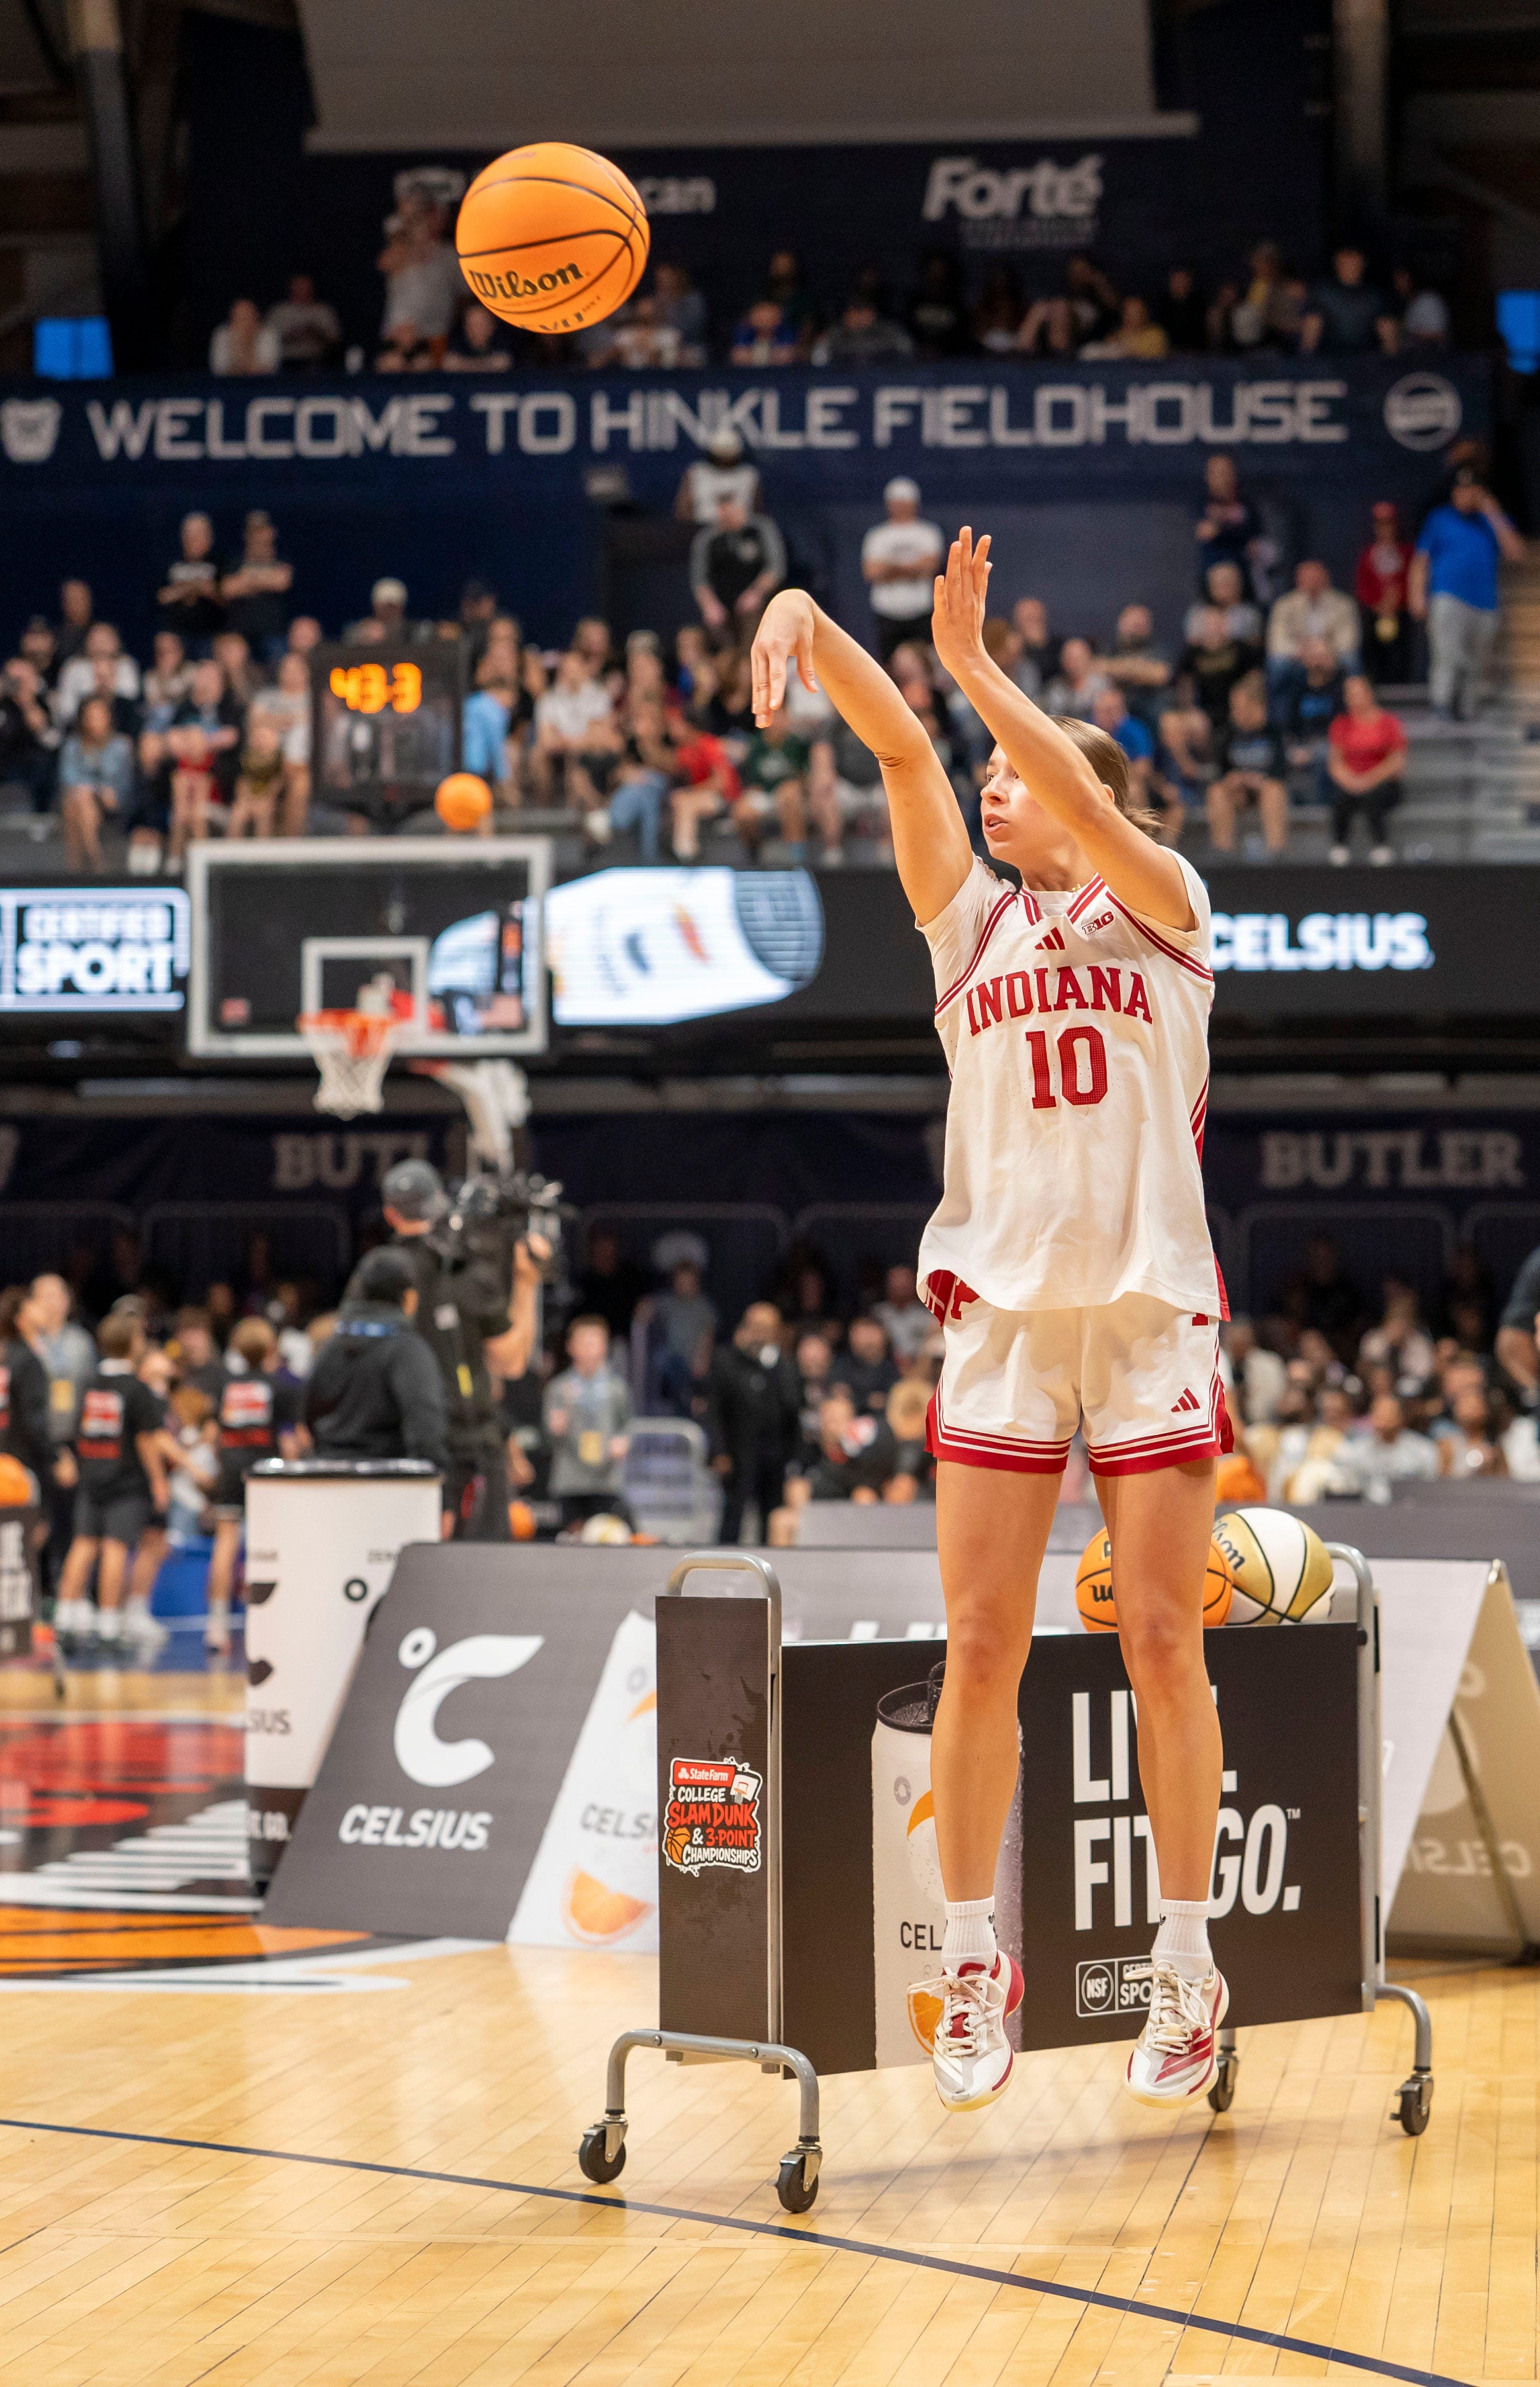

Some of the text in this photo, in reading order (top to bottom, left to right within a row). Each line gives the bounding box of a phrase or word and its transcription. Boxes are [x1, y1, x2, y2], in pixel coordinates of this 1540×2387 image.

[922, 153, 1104, 221] Forté
[468, 263, 584, 299] Wilson
[86, 394, 456, 461] WELCOME
[471, 392, 576, 455] TO
[590, 387, 860, 453] HINKLE
[874, 379, 1348, 449] FIELDHOUSE
[16, 942, 173, 994] SPORT
[966, 966, 1152, 1037] INDIANA
[1026, 1025, 1108, 1109] 10
[1261, 1129, 1524, 1188] BUTLER
[677, 1787, 726, 1803] COLLEGE
[338, 1803, 494, 1851] CELSIUS
[580, 1803, 658, 1840] CELSI
[668, 1801, 756, 1829] SLAM DUNK
[682, 1844, 757, 1866] CHAMPIONSHIPS
[692, 1827, 757, 1848] & 3-POINT
[900, 1921, 946, 1951] CEL
[1086, 1977, 1108, 1999] NSF
[1120, 1980, 1153, 2006] SPO
